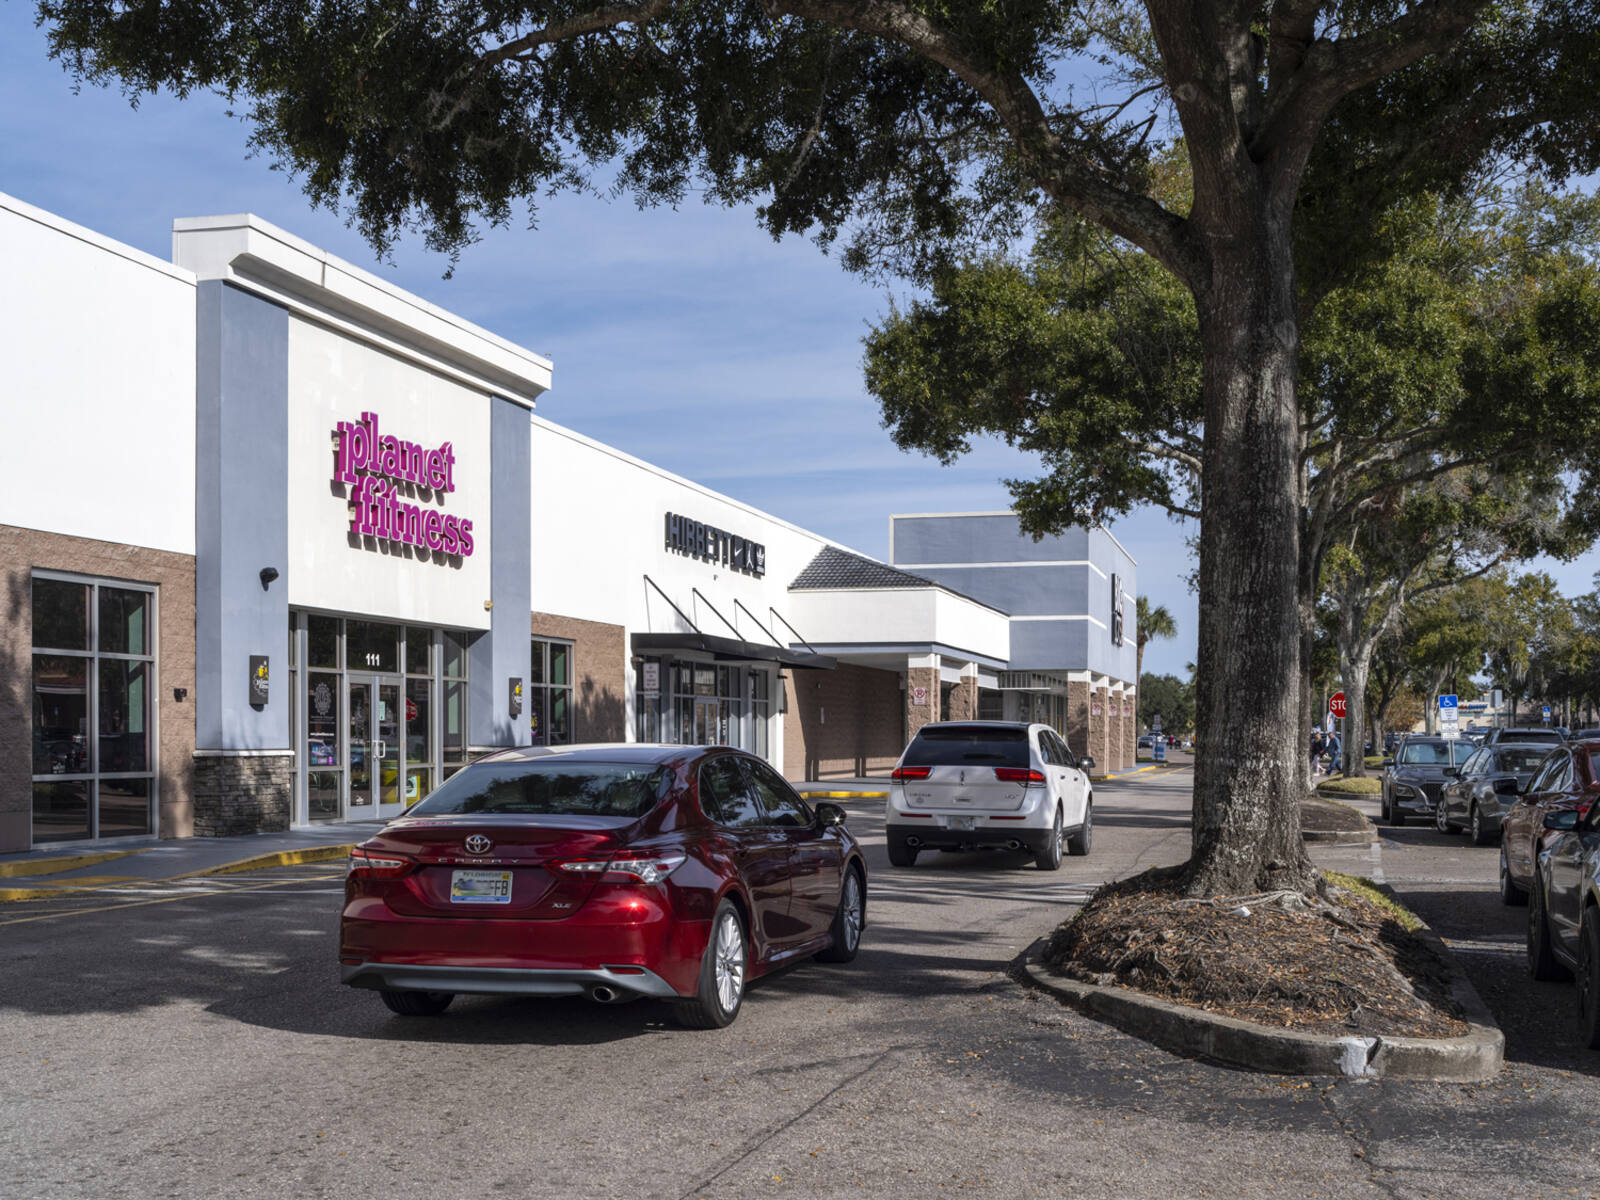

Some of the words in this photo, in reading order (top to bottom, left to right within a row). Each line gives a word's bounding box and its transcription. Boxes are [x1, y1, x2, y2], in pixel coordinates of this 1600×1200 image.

[335, 411, 456, 493] planet
[353, 475, 474, 557] fitness
[665, 511, 732, 564] HIBBETT
[365, 652, 380, 667] 111
[1330, 700, 1346, 710] STO
